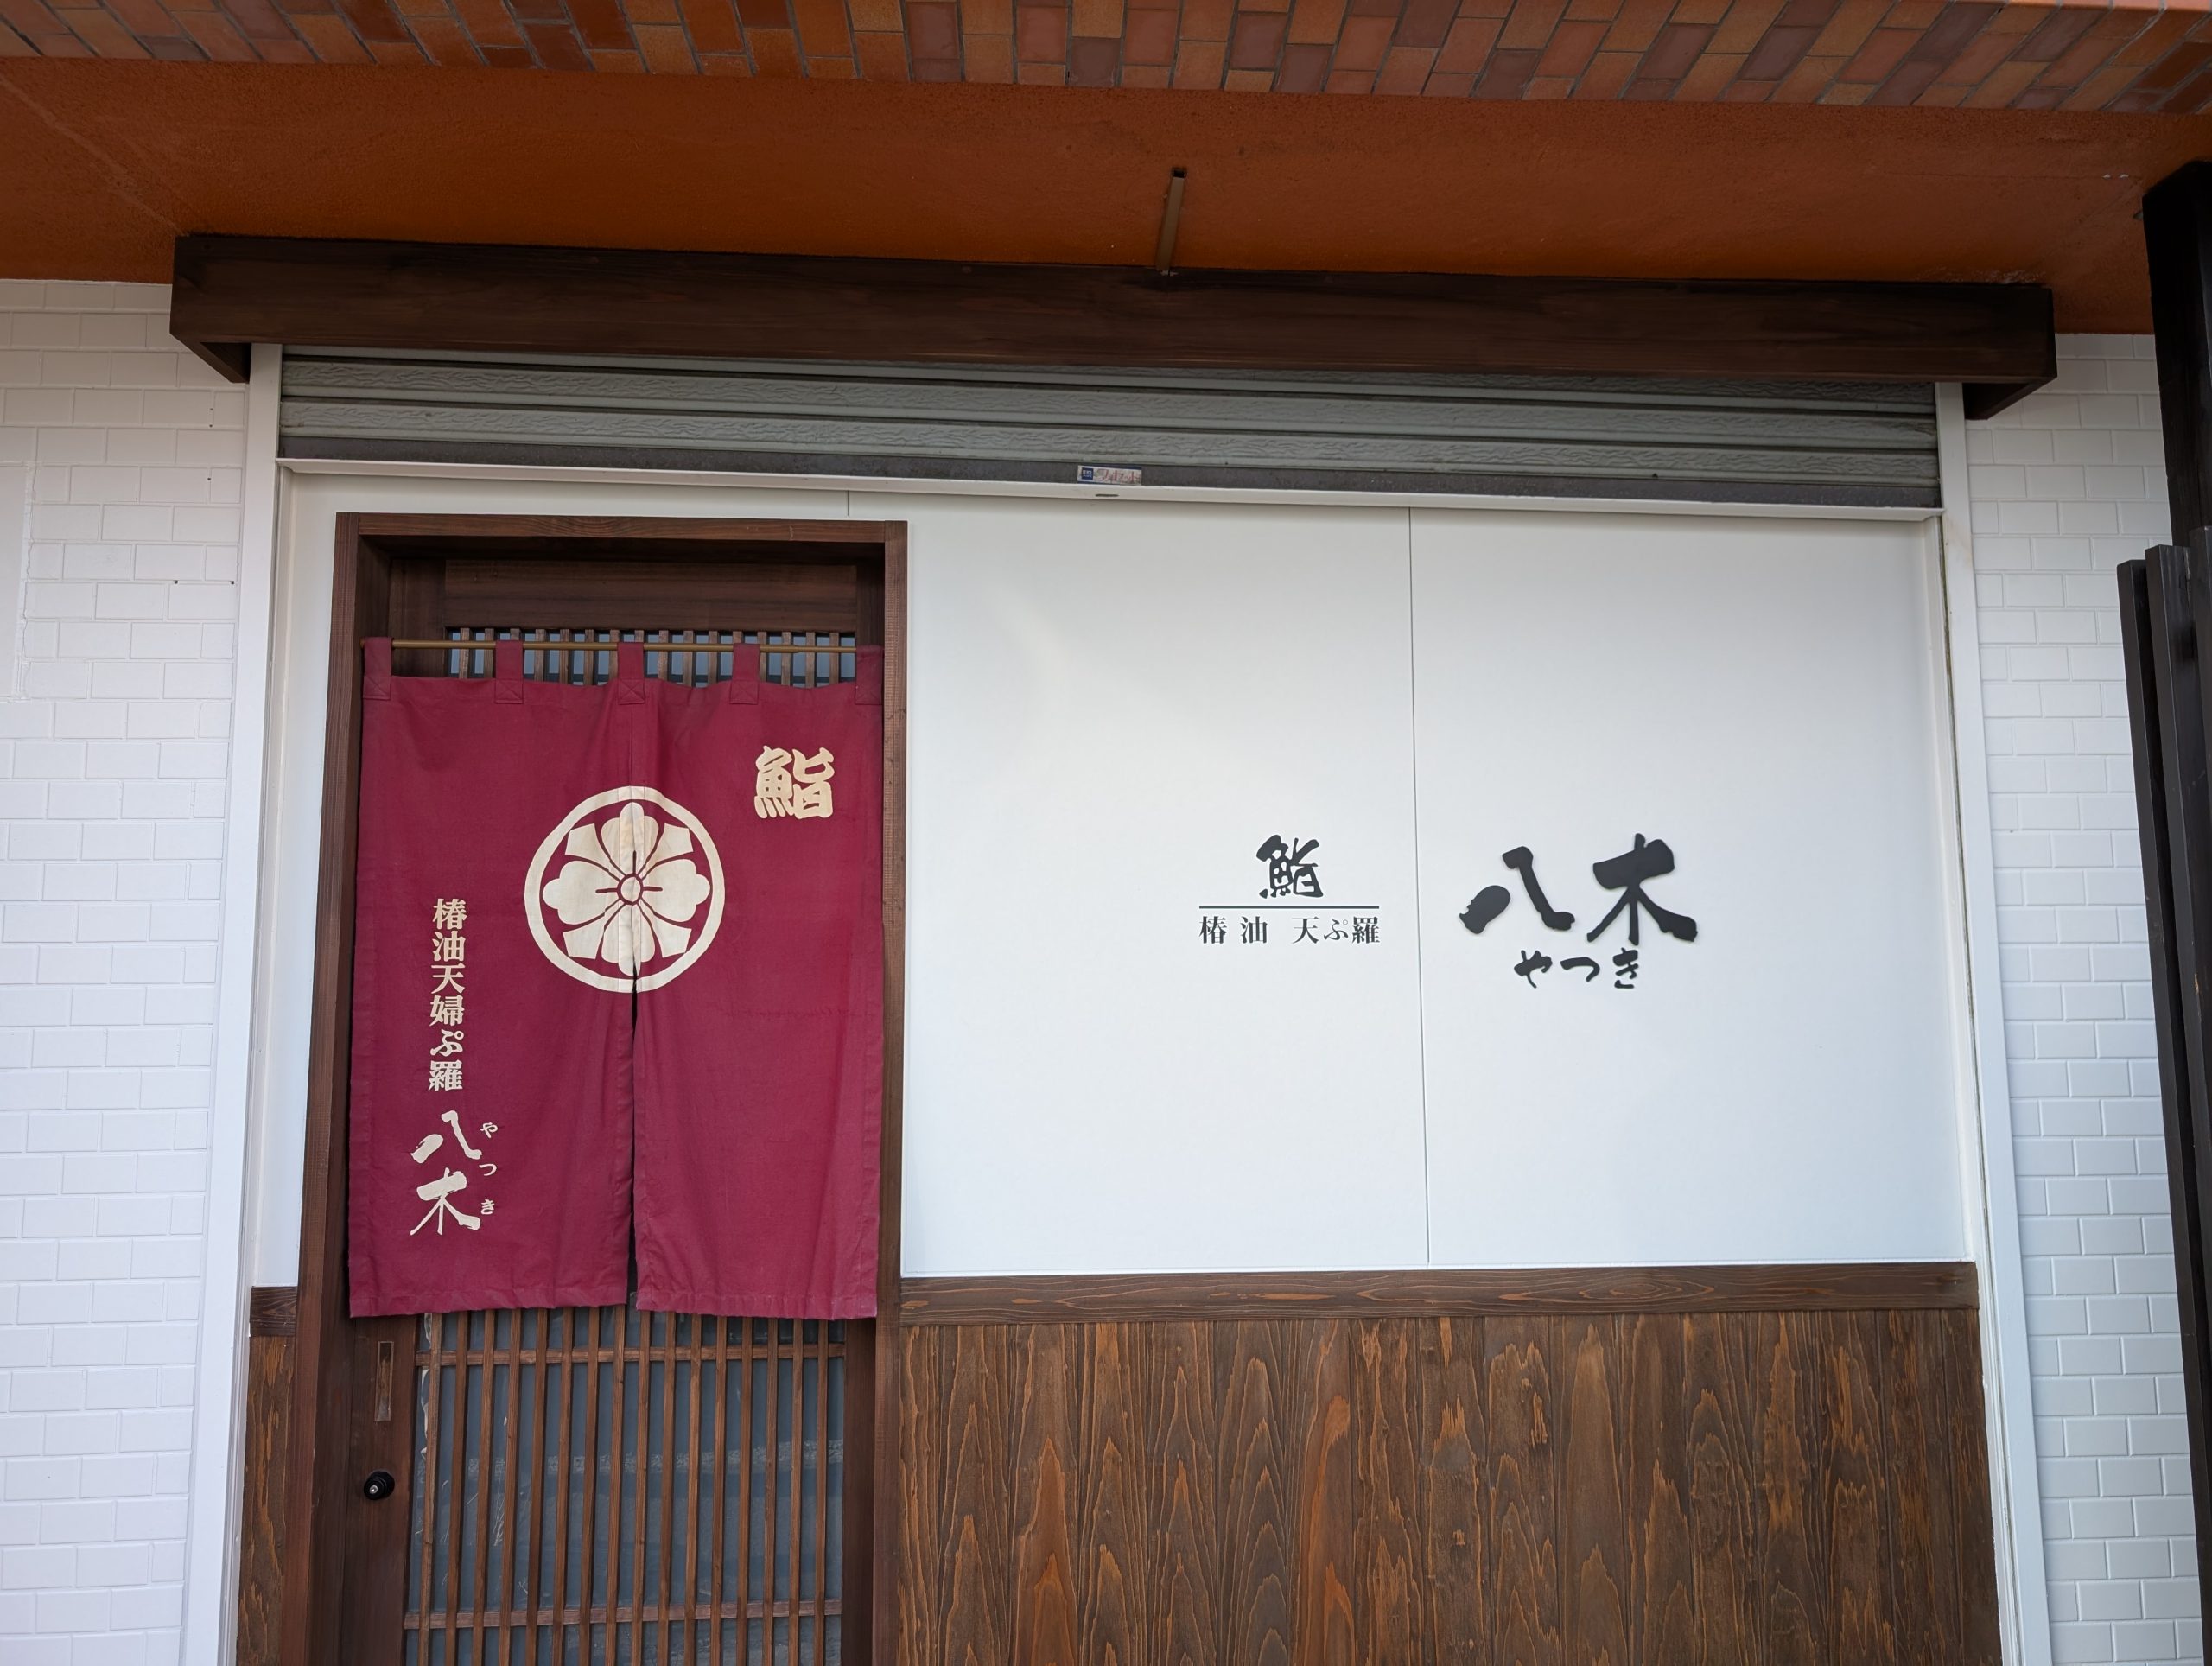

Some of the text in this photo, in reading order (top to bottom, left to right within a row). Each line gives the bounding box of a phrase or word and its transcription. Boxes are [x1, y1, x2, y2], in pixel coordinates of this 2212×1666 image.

[753, 745, 836, 820] 鮨
[1255, 834, 1324, 900] 鮨
[1459, 832, 1699, 945] 八木
[1198, 915, 1381, 944] 椿油 天ぷ羅
[1513, 947, 1639, 989] やつき
[428, 898, 467, 1091] 椿油天婦ぷ羅
[410, 1110, 483, 1236] 八木
[479, 1122, 499, 1215] やつき
